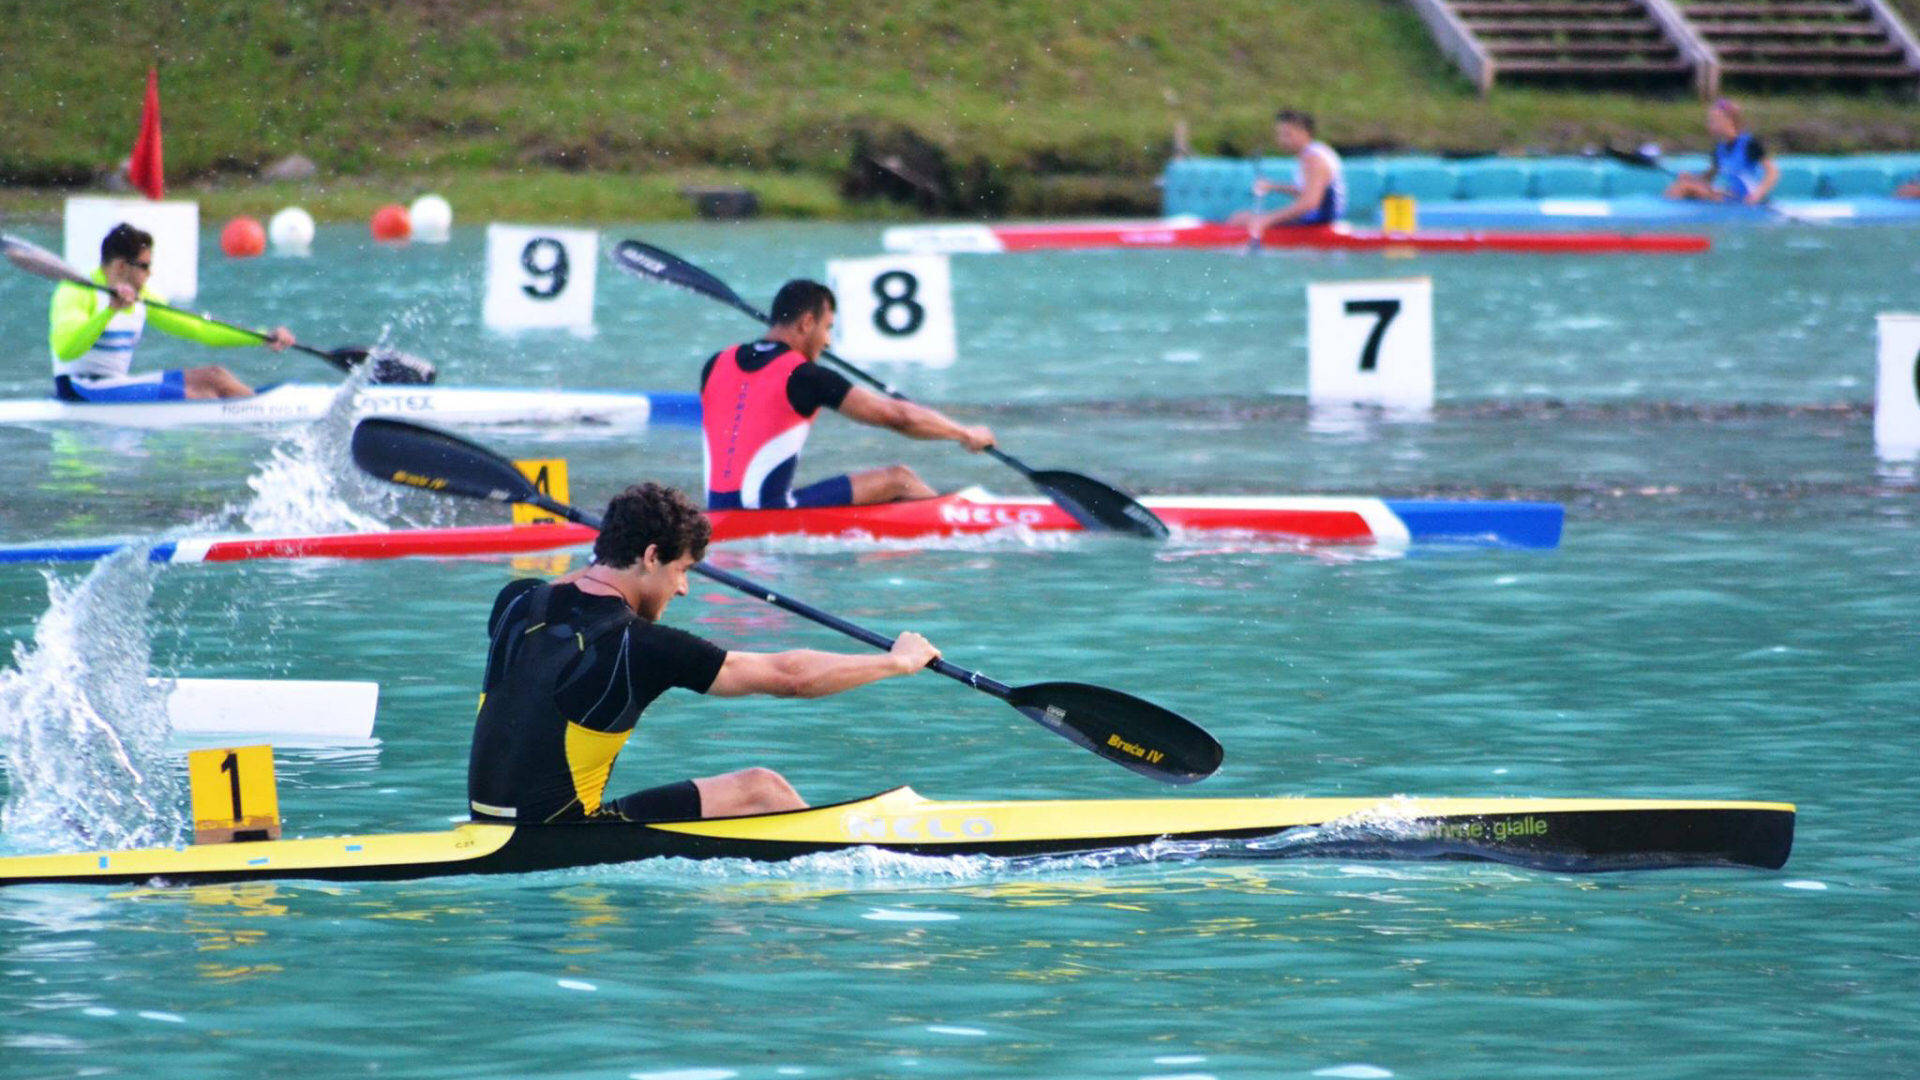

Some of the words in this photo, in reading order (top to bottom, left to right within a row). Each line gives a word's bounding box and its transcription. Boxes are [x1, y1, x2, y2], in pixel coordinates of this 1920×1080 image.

[523, 239, 568, 298] 9
[874, 271, 923, 336] 8
[1345, 300, 1400, 370] 7
[941, 504, 1043, 524] NELO
[1146, 749, 1165, 764] IV
[221, 754, 242, 822] 1
[846, 815, 996, 839] NELO
[1493, 816, 1548, 841] gialle
